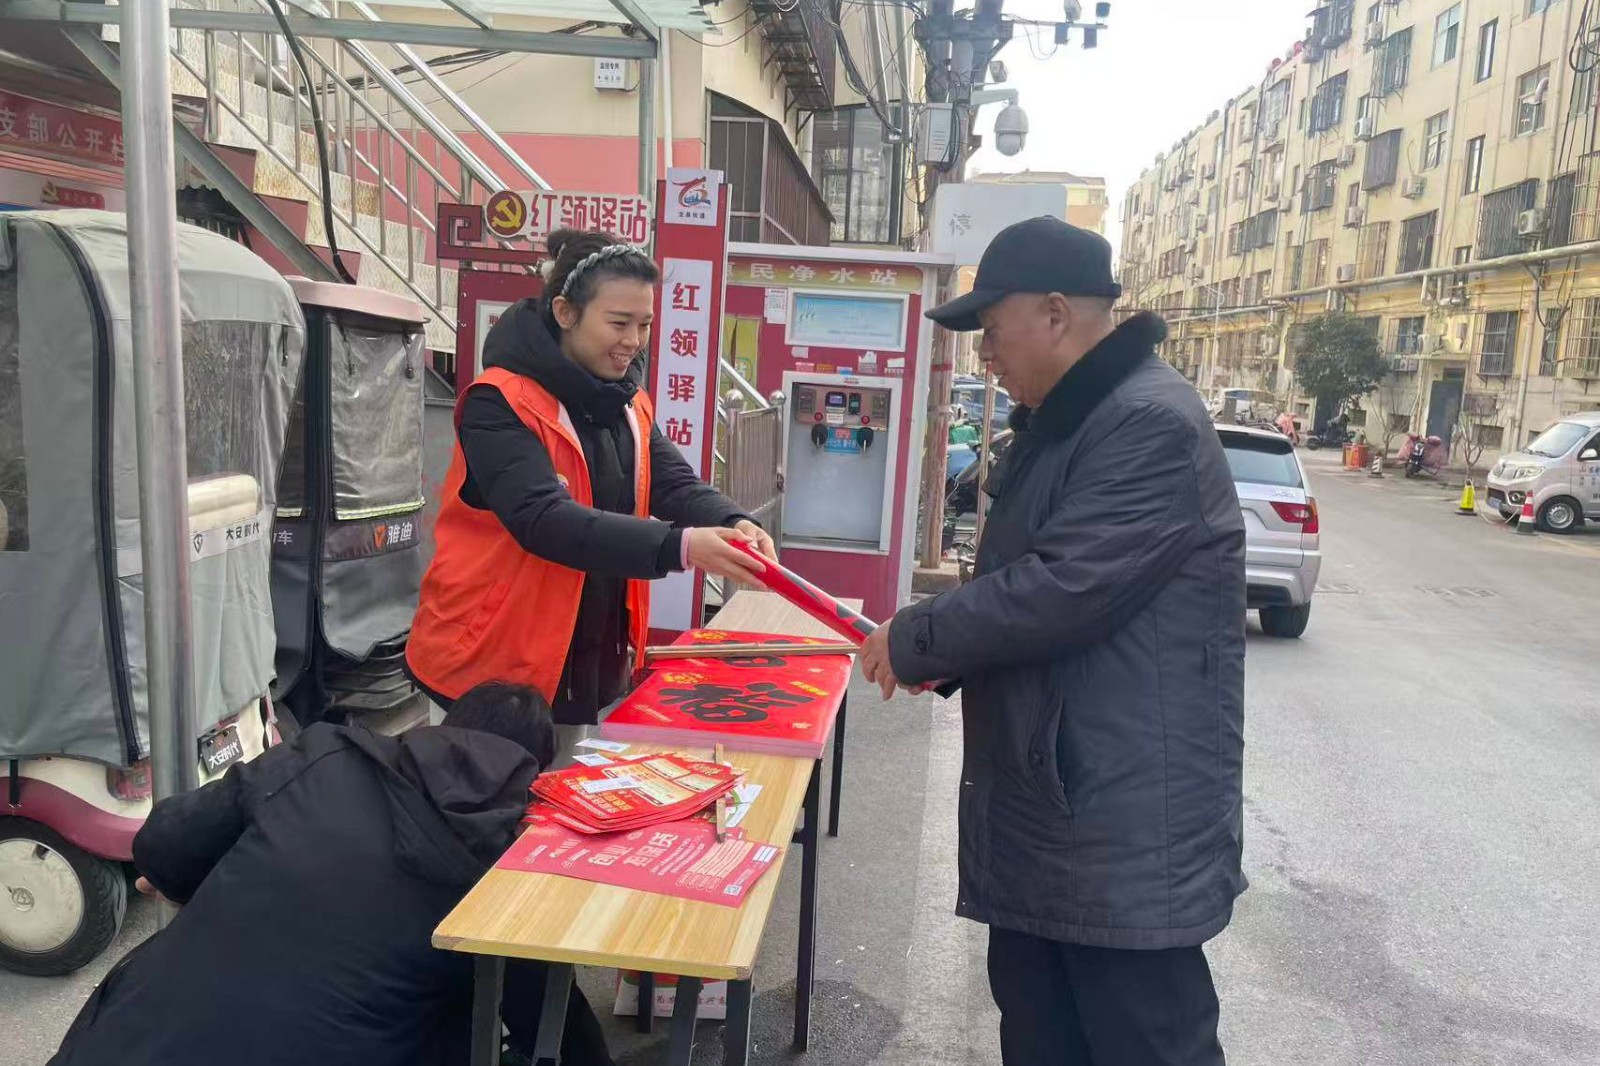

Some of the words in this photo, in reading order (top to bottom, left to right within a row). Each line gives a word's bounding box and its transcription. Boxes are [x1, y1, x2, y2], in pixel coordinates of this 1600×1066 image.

[530, 193, 648, 244] 红领驿站
[666, 282, 701, 447] 红领驿站
[226, 521, 260, 540] 大安时代
[273, 530, 293, 545] 车
[387, 522, 413, 545] 雅迪
[209, 739, 240, 769] 大安时代
